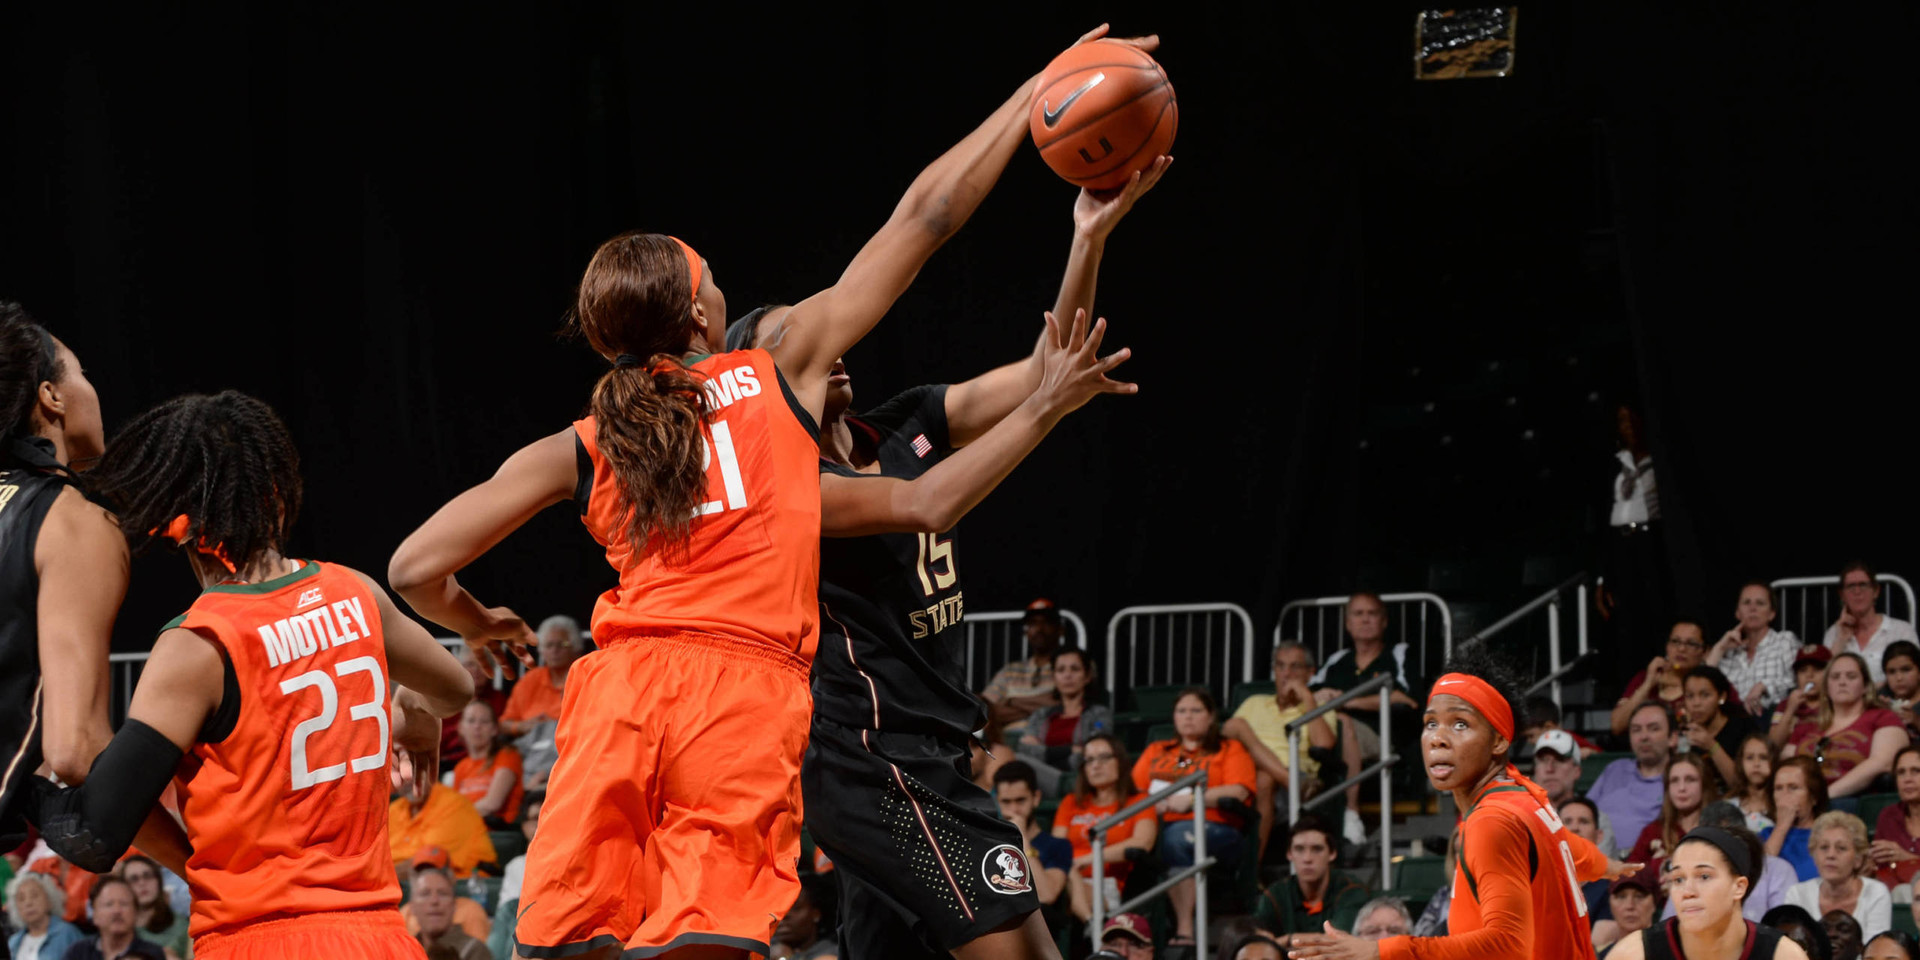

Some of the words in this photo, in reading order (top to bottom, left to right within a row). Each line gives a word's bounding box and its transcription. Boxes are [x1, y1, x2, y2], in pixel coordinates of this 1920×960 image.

[697, 365, 762, 412] MS
[916, 531, 957, 597] 15
[297, 587, 324, 609] ACC
[908, 590, 964, 640] STATE
[257, 596, 372, 669] MOTLEY
[278, 655, 390, 792] 23
